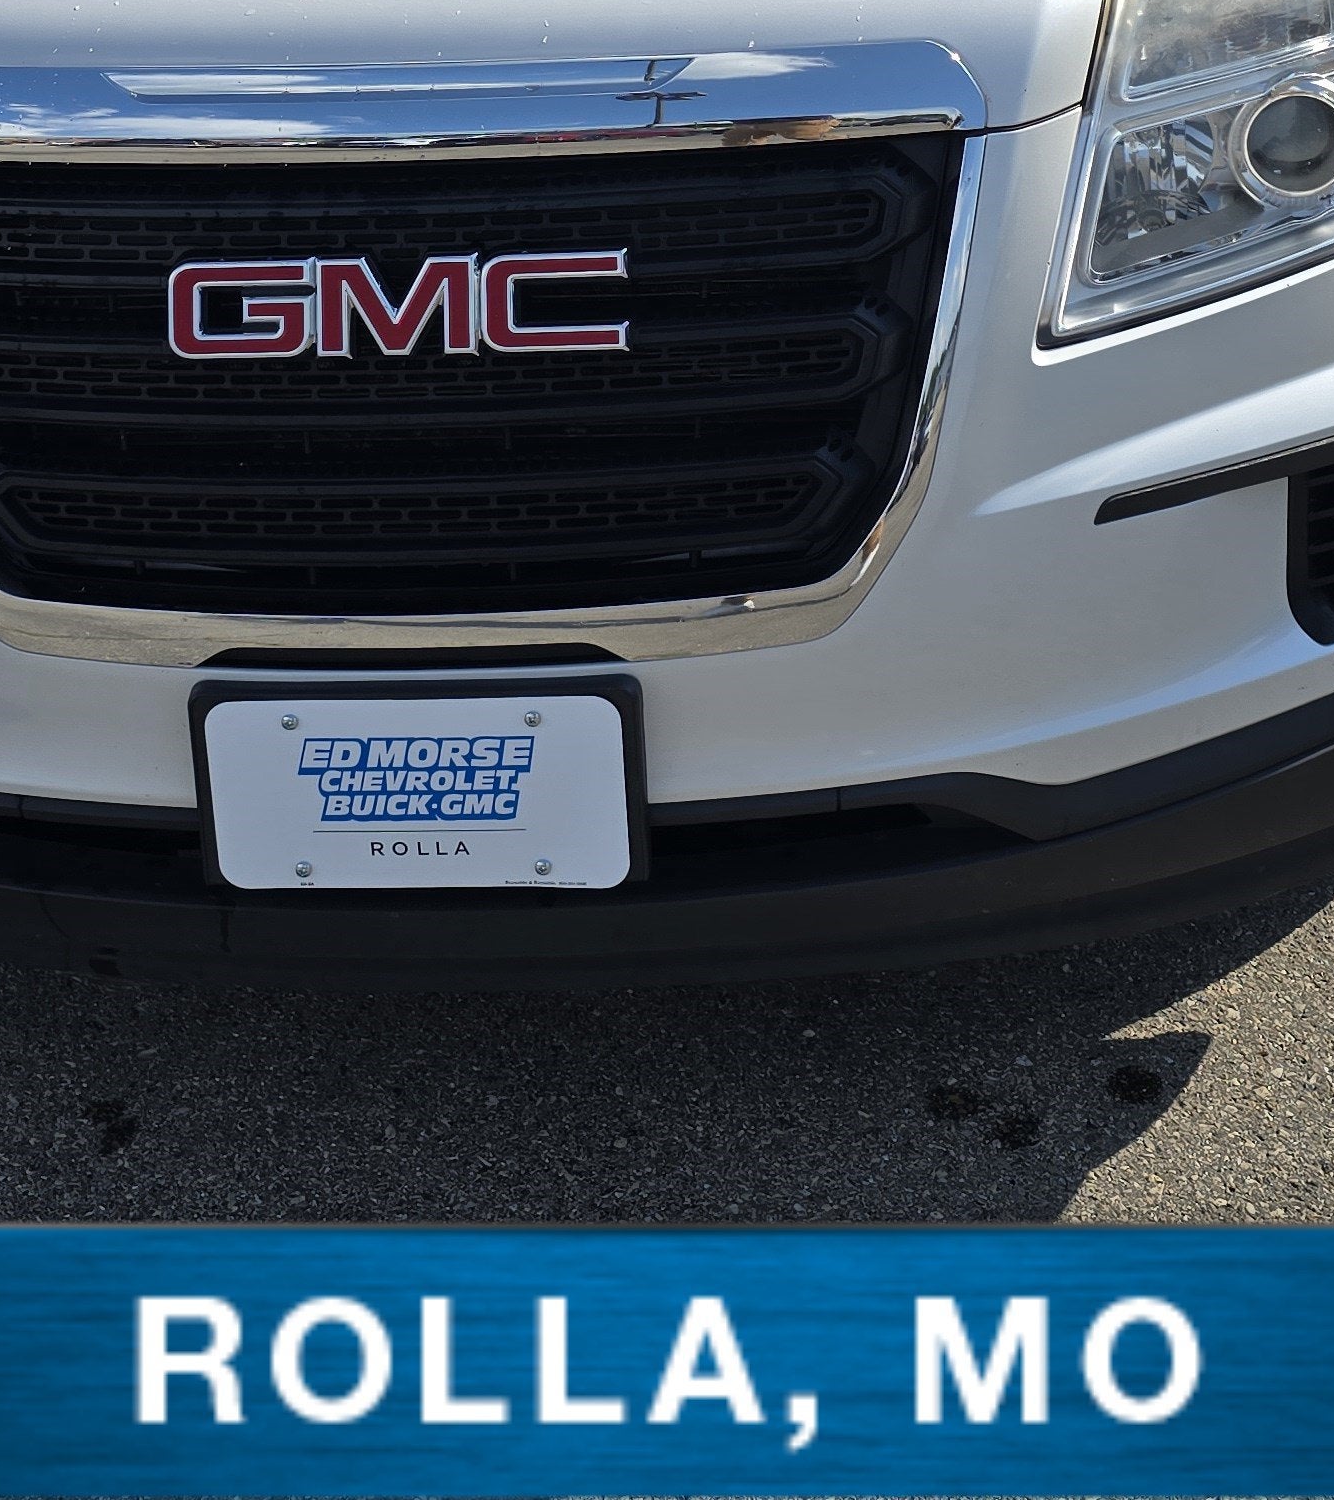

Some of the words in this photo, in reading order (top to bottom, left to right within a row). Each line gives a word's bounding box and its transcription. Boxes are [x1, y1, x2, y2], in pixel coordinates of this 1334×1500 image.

[167, 246, 631, 361] GMC
[300, 740, 362, 769] ED
[366, 738, 533, 768] MORSE
[320, 769, 516, 792] CHEVROLET
[370, 840, 470, 857] ROLLA
